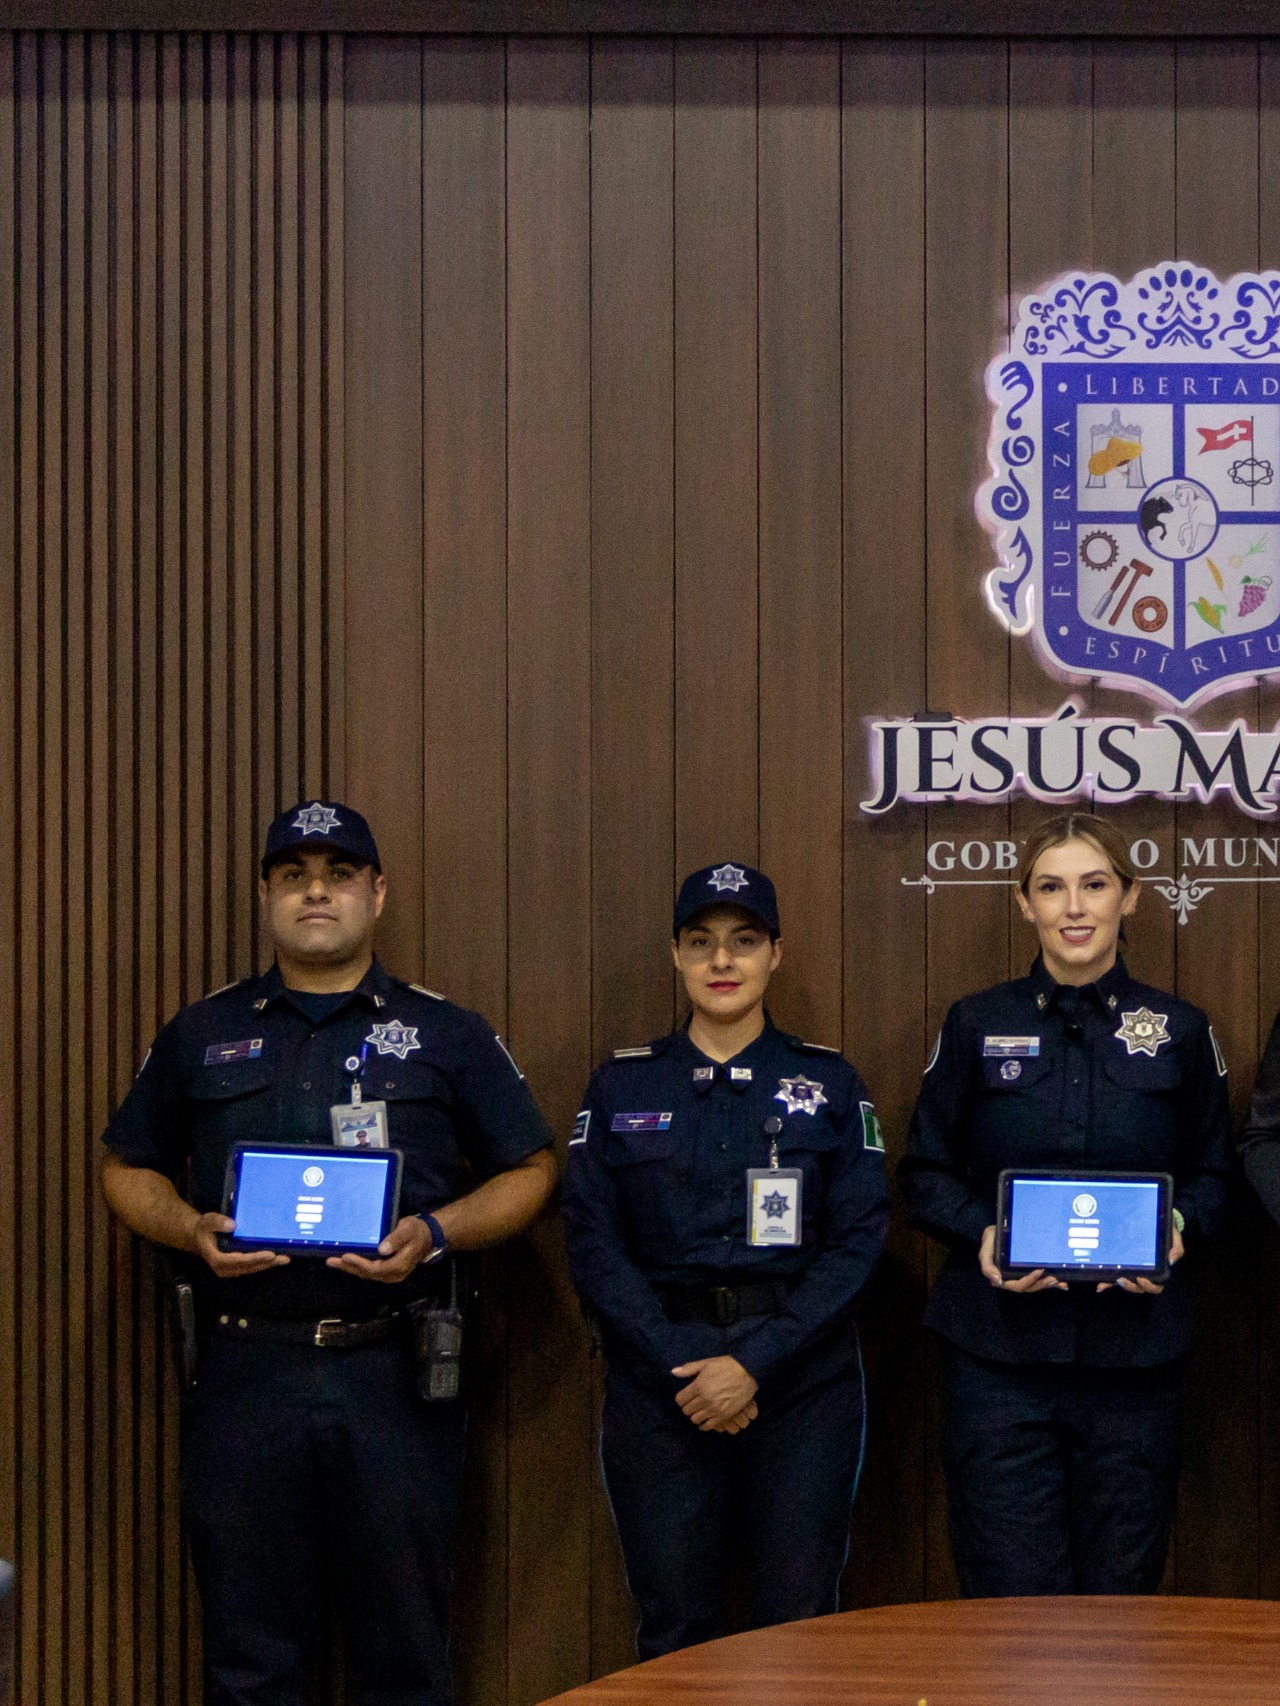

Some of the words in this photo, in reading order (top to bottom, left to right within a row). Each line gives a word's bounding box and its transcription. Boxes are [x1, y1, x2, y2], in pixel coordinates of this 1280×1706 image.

[1084, 373, 1280, 397] LIBERTAD
[1051, 420, 1072, 598] FUERZA
[861, 705, 1143, 811] JESÚS
[926, 838, 1160, 871] GOBO
